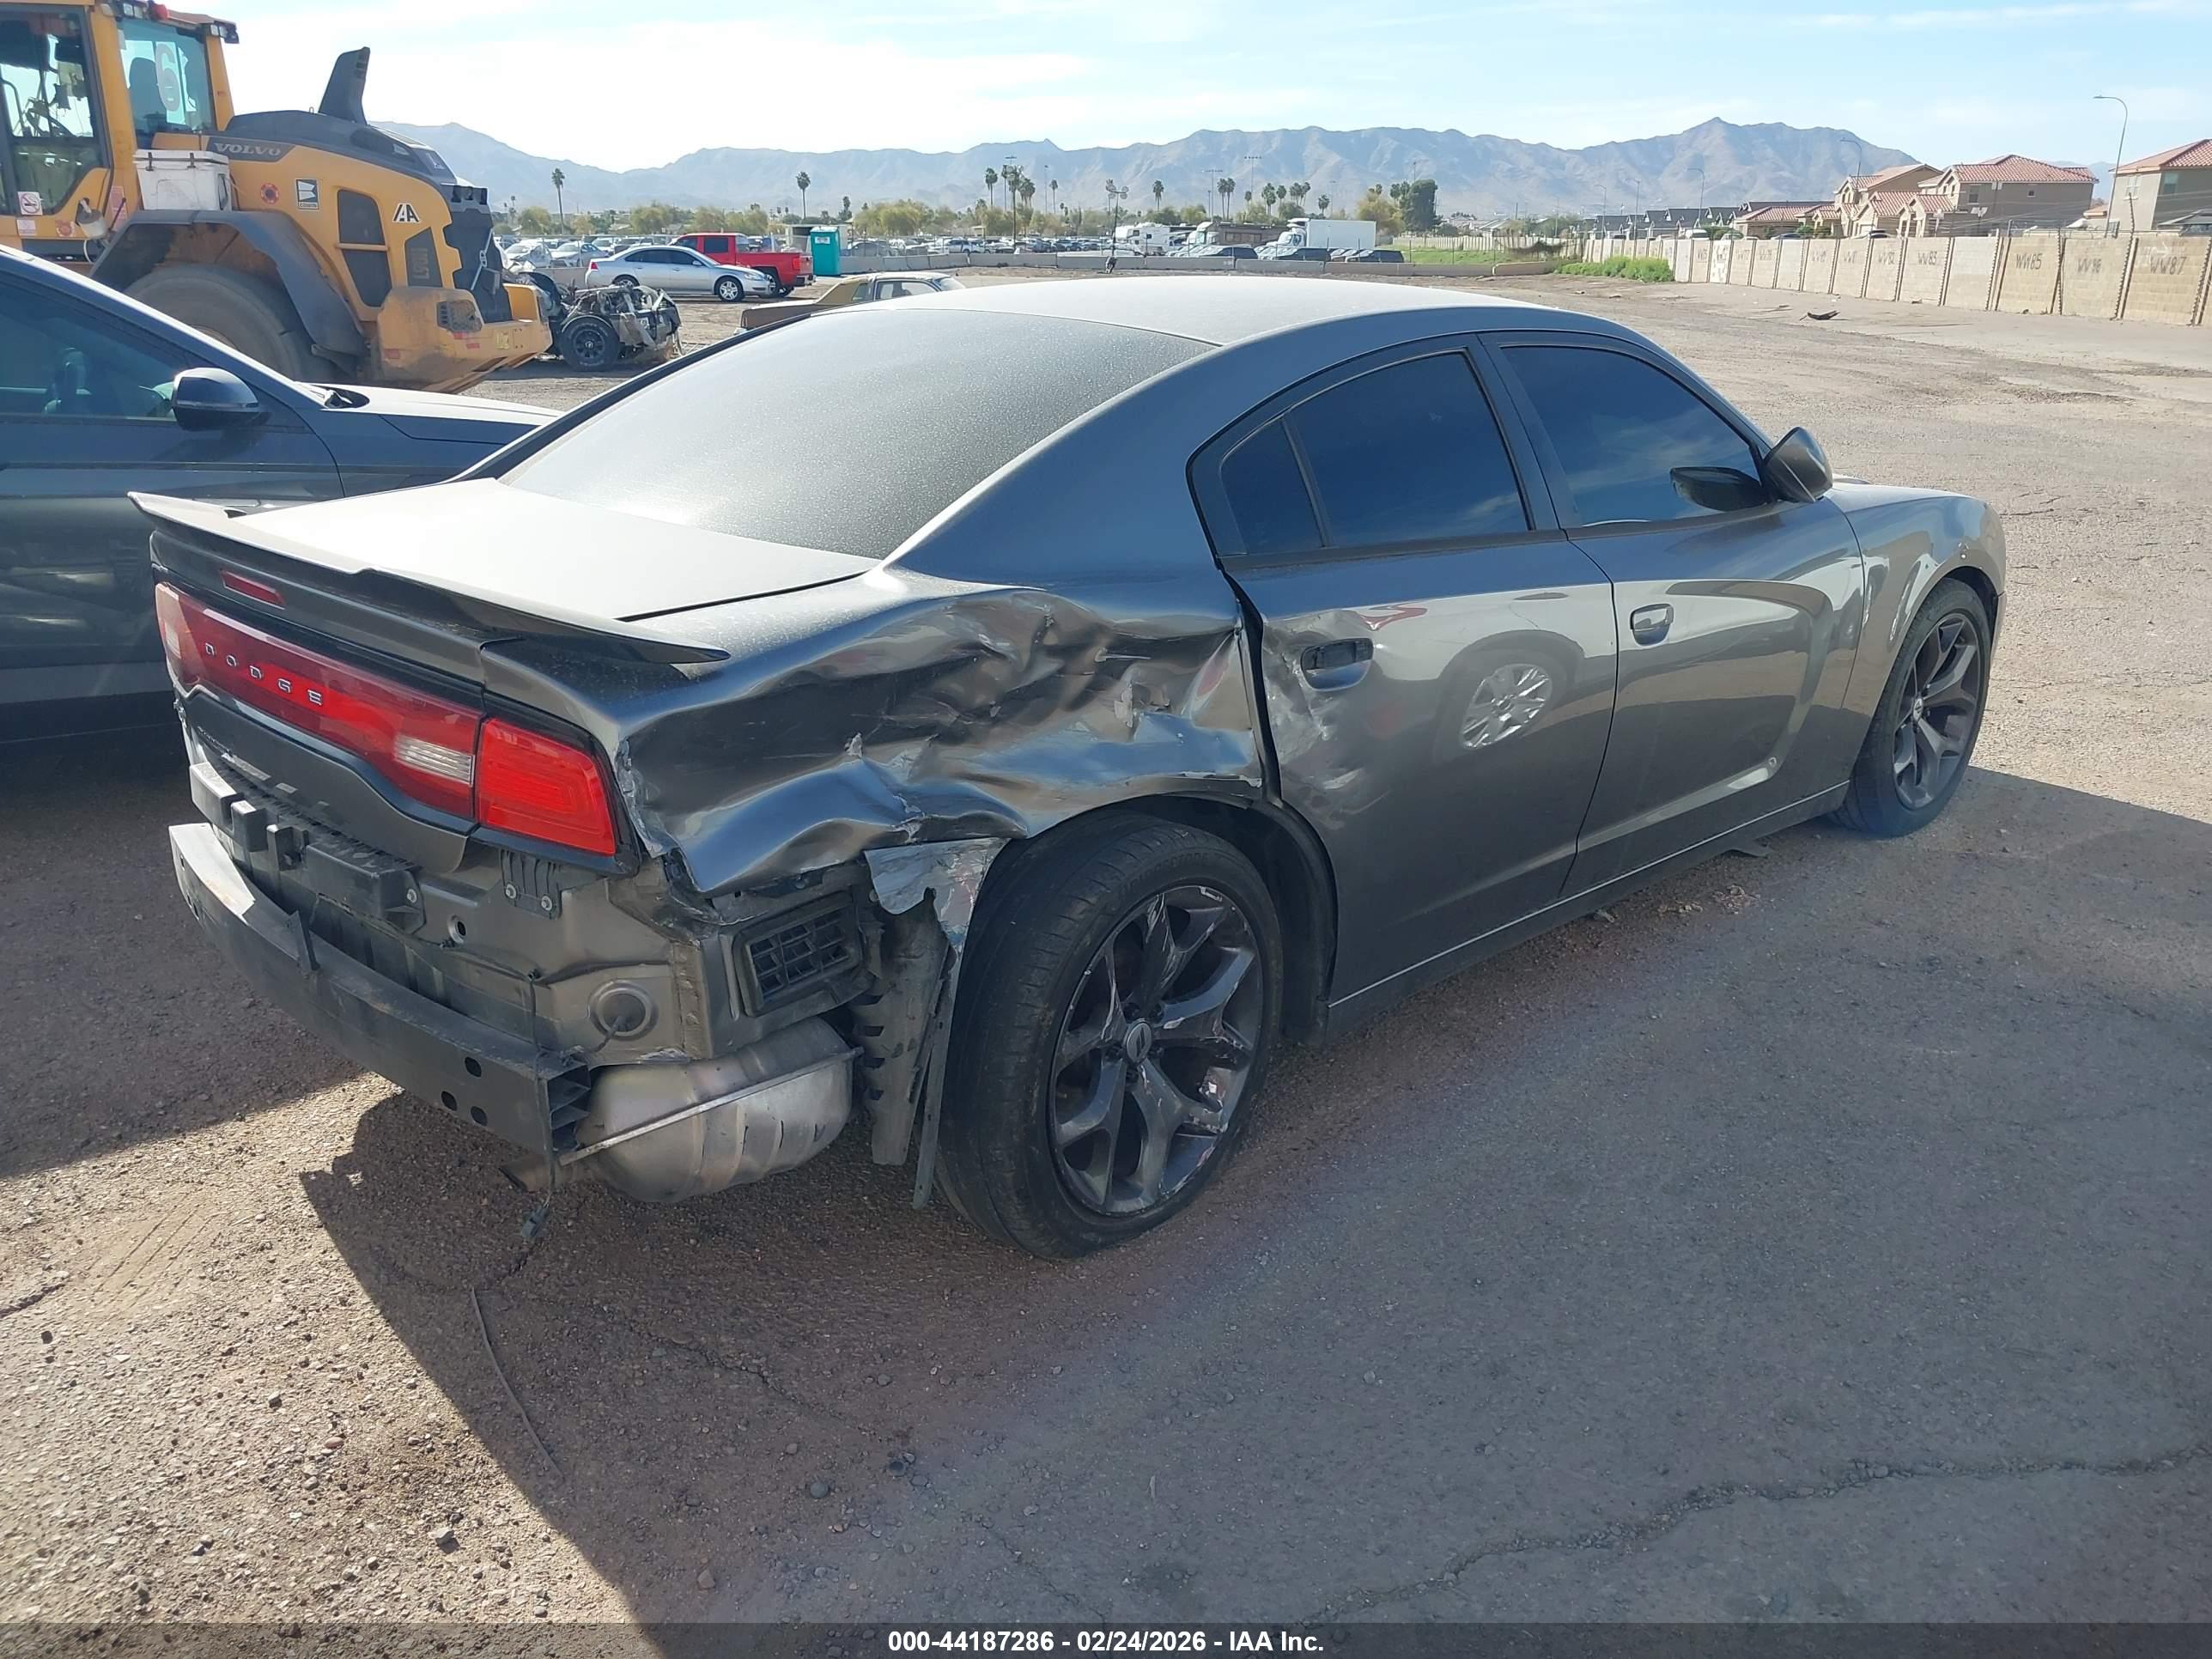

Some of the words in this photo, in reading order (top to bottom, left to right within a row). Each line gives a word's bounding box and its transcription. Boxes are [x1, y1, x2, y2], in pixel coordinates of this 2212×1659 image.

[215, 143, 282, 156] VOLVO
[2015, 252, 2042, 270] WW85
[2149, 255, 2187, 275] WW87
[204, 642, 322, 706] DODGE
